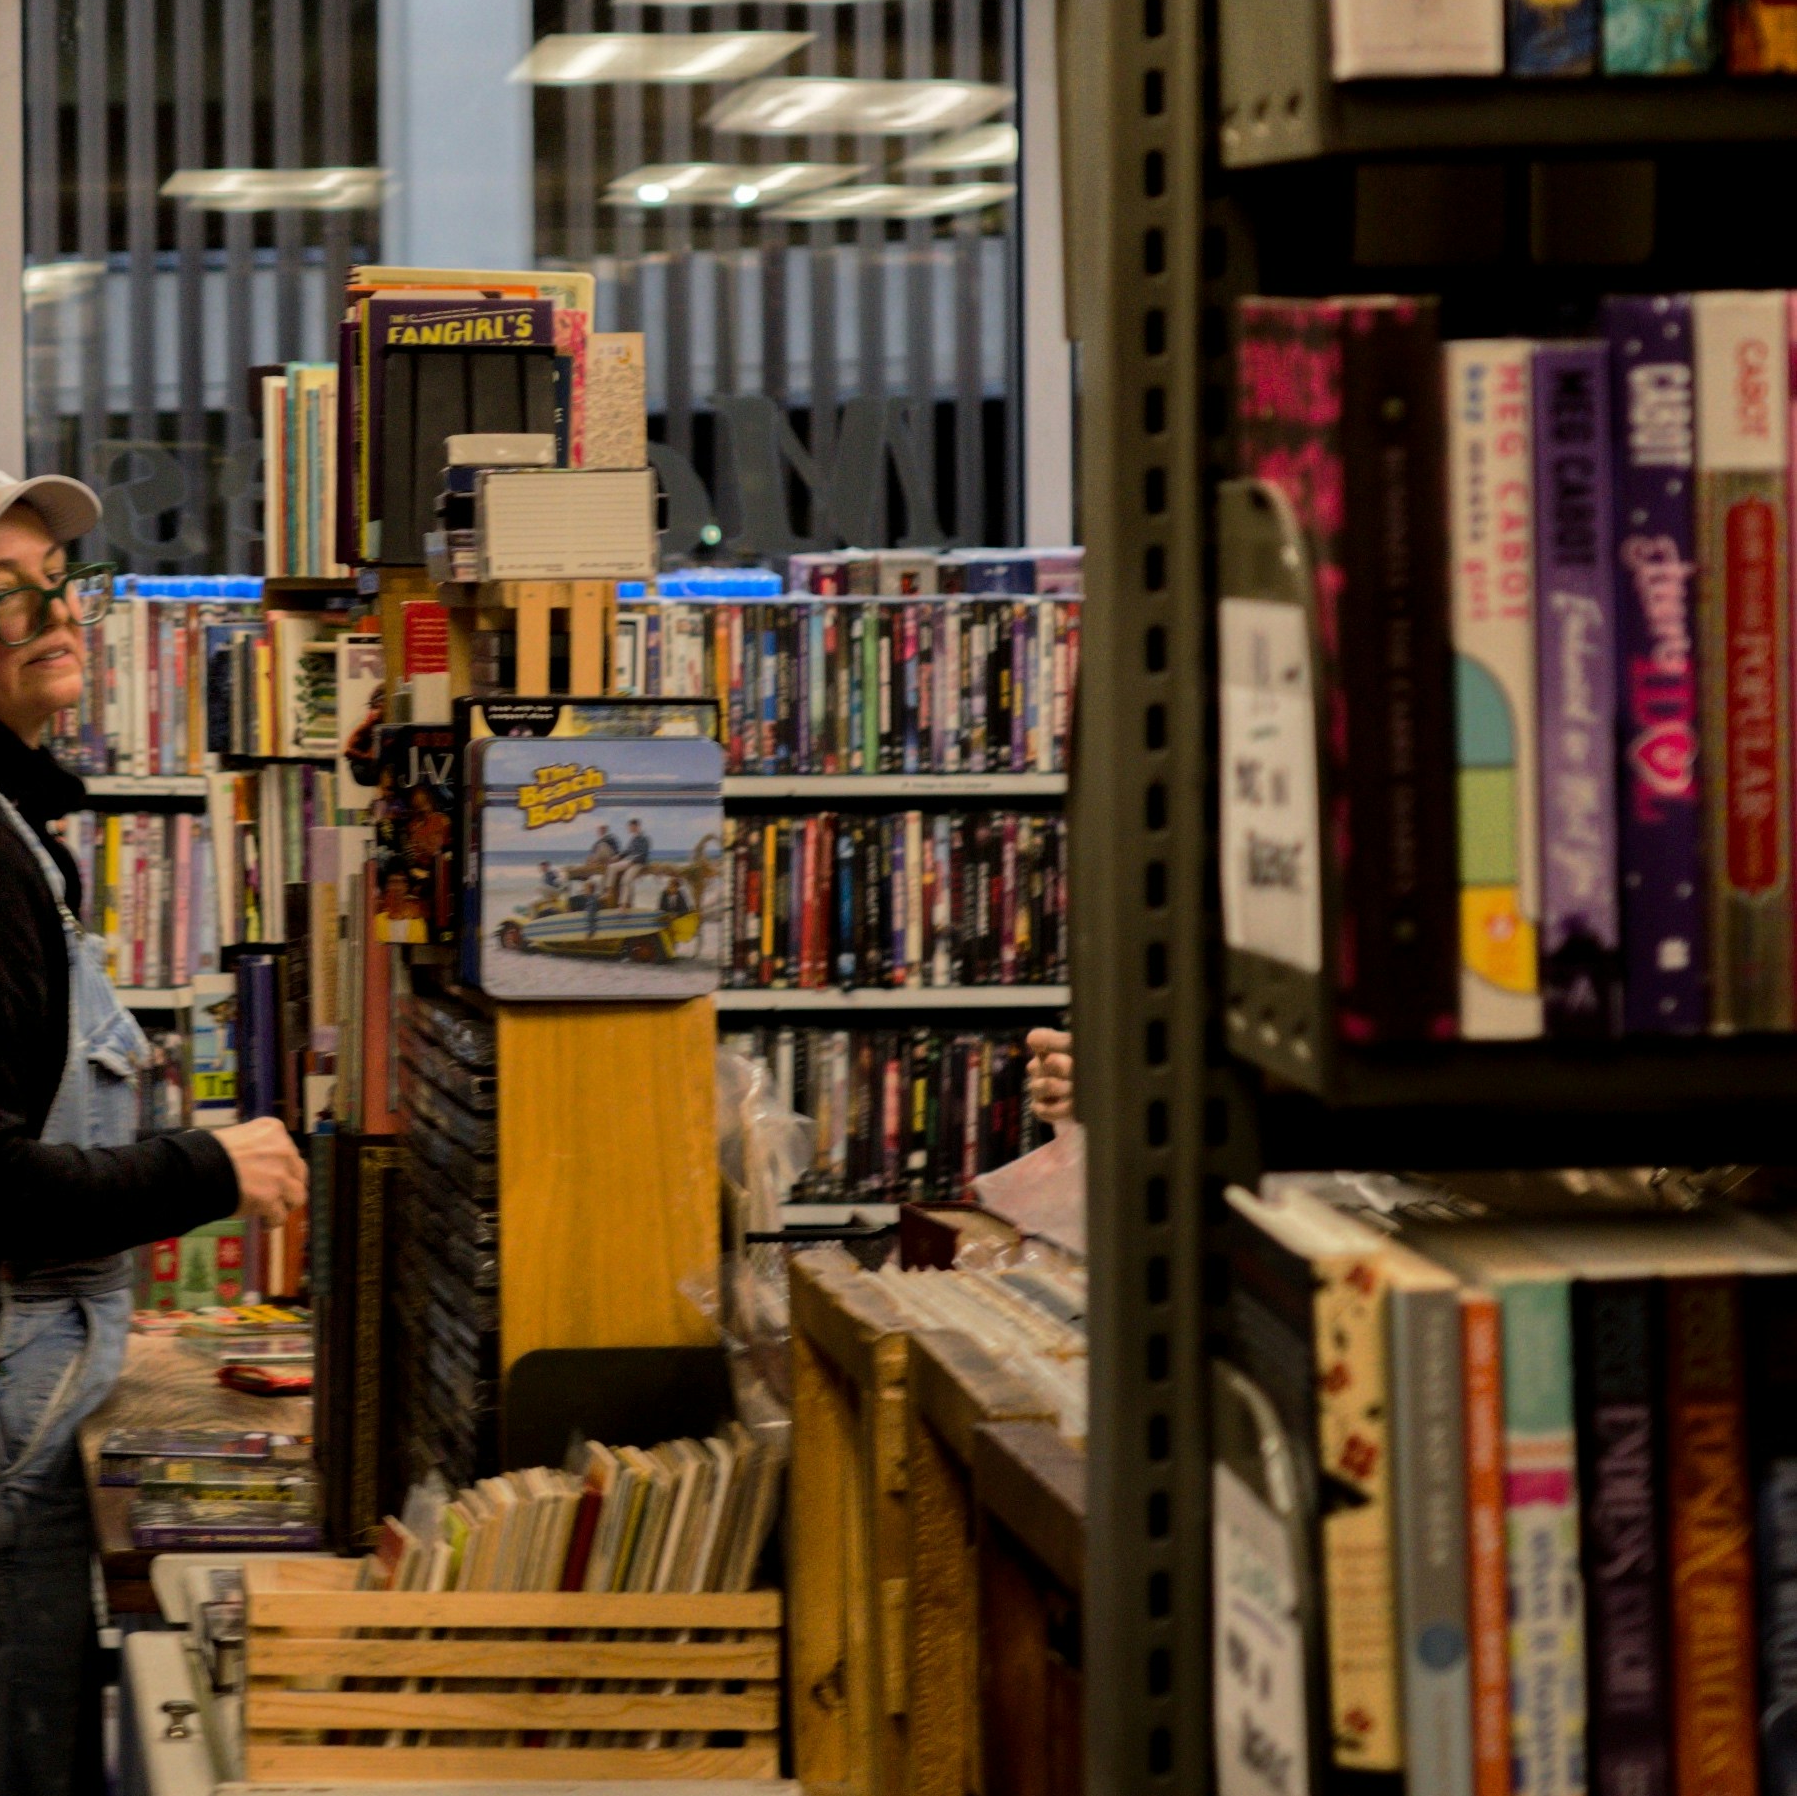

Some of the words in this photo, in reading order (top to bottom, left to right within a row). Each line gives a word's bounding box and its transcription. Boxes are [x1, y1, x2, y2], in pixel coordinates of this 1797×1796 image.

[387, 313, 534, 345] FANGIRL'S
[1463, 363, 1491, 425] boy
[1494, 362, 1529, 459] MEG
[1551, 369, 1596, 449] MEG
[1628, 361, 1695, 469] CABOT
[1735, 339, 1770, 438] CABOT
[1466, 440, 1490, 544] meets
[1555, 454, 1600, 572] CABOT
[1462, 558, 1491, 621] girl
[1495, 479, 1530, 622] CABOT
[1730, 631, 1775, 821] POPULAR
[517, 766, 605, 808] Beach
[525, 792, 596, 830] Boys
[535, 763, 578, 786] The
